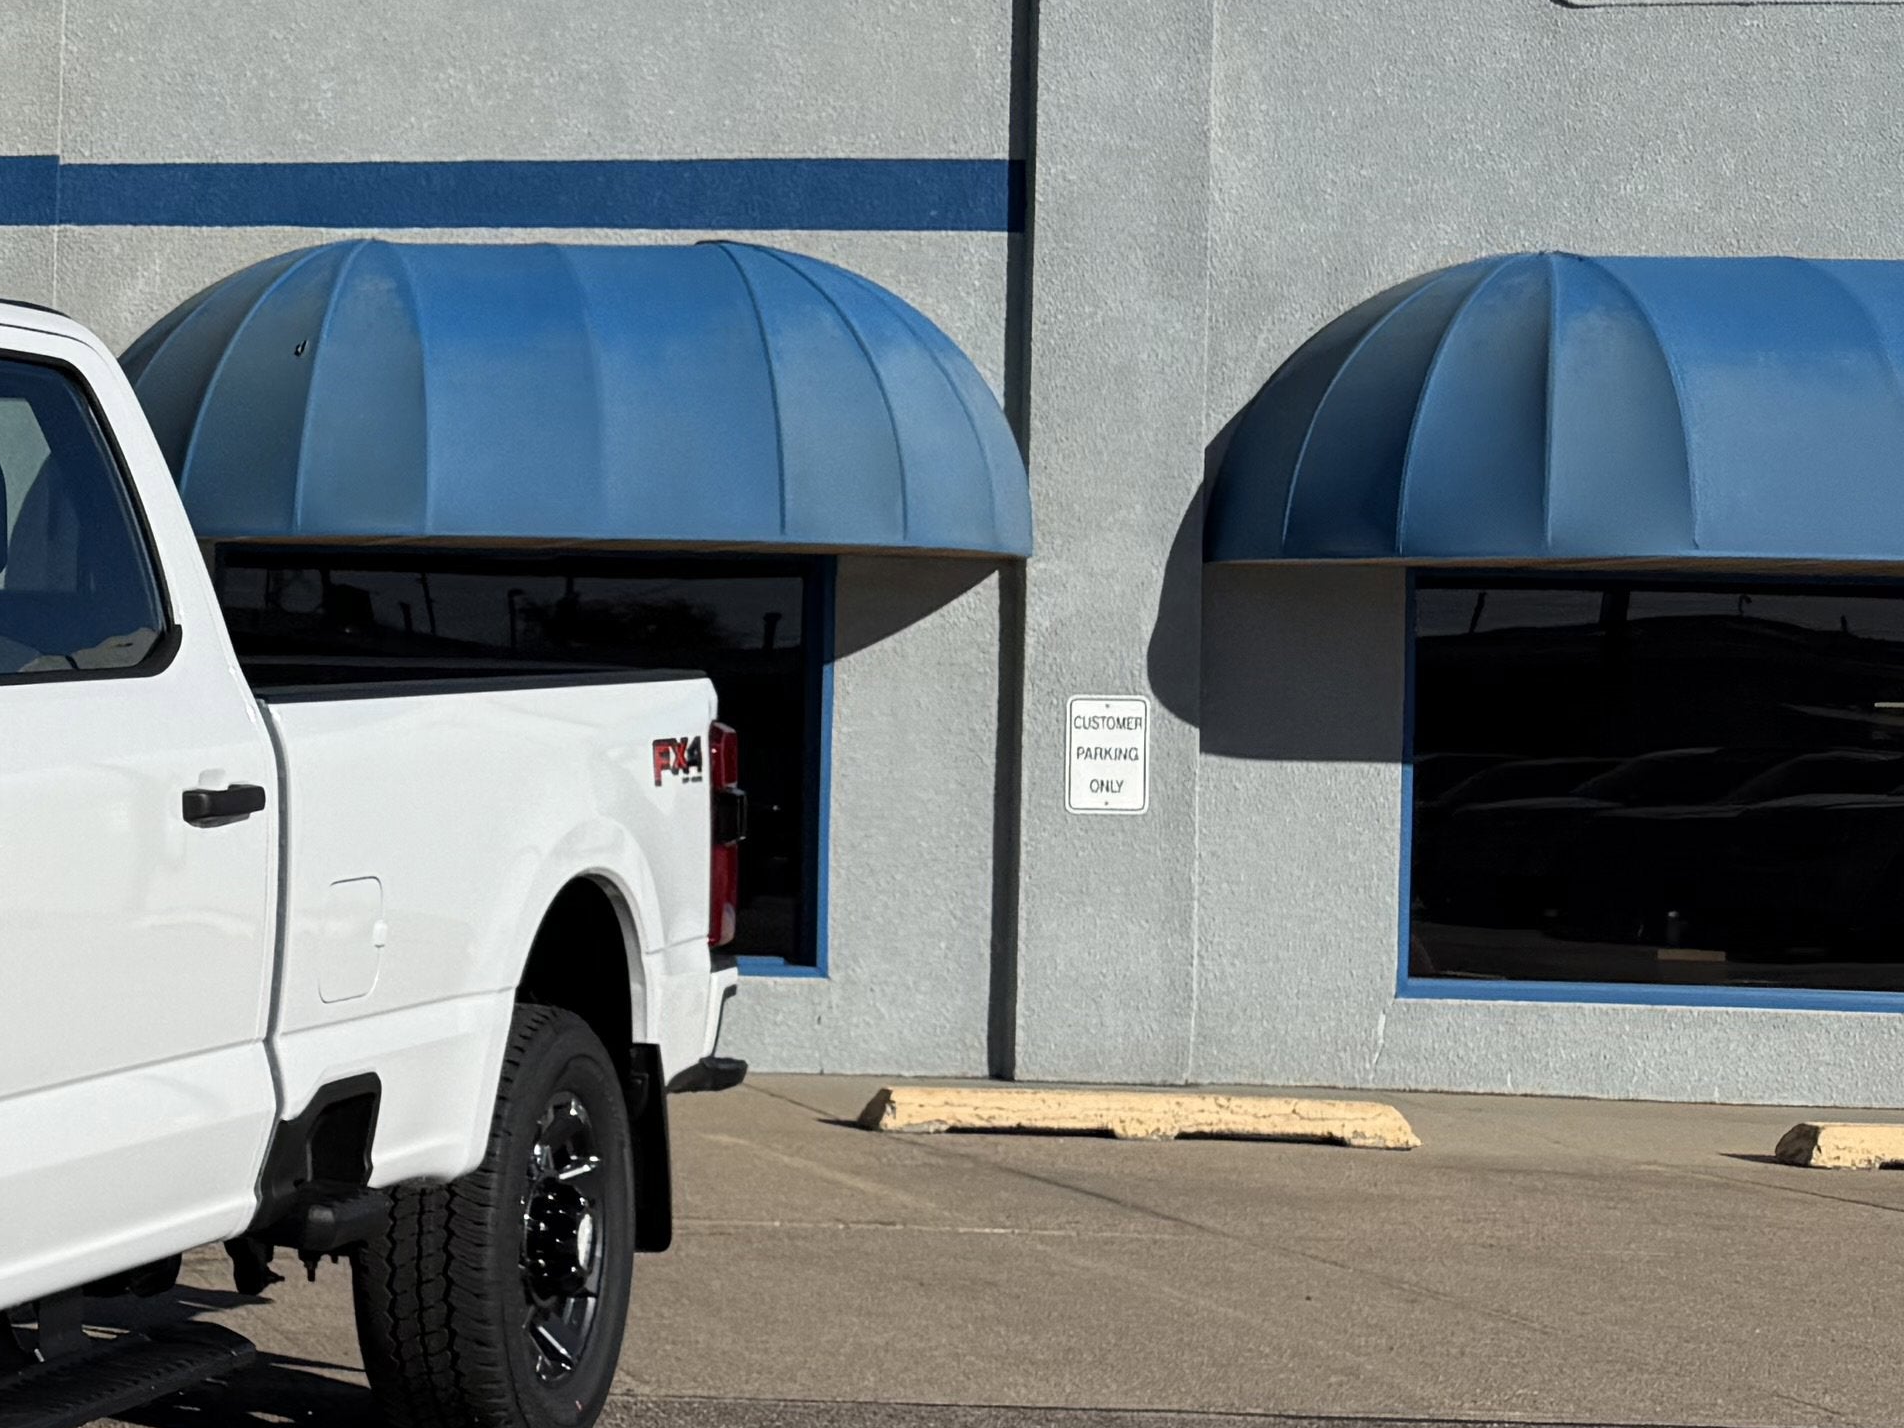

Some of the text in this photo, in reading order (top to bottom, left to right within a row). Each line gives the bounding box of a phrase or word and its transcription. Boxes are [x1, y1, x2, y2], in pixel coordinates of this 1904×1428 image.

[1073, 715, 1143, 730] CUSTOMER
[652, 736, 702, 786] FX4
[1076, 746, 1139, 761] PARKING
[1089, 779, 1124, 793] ONLY
